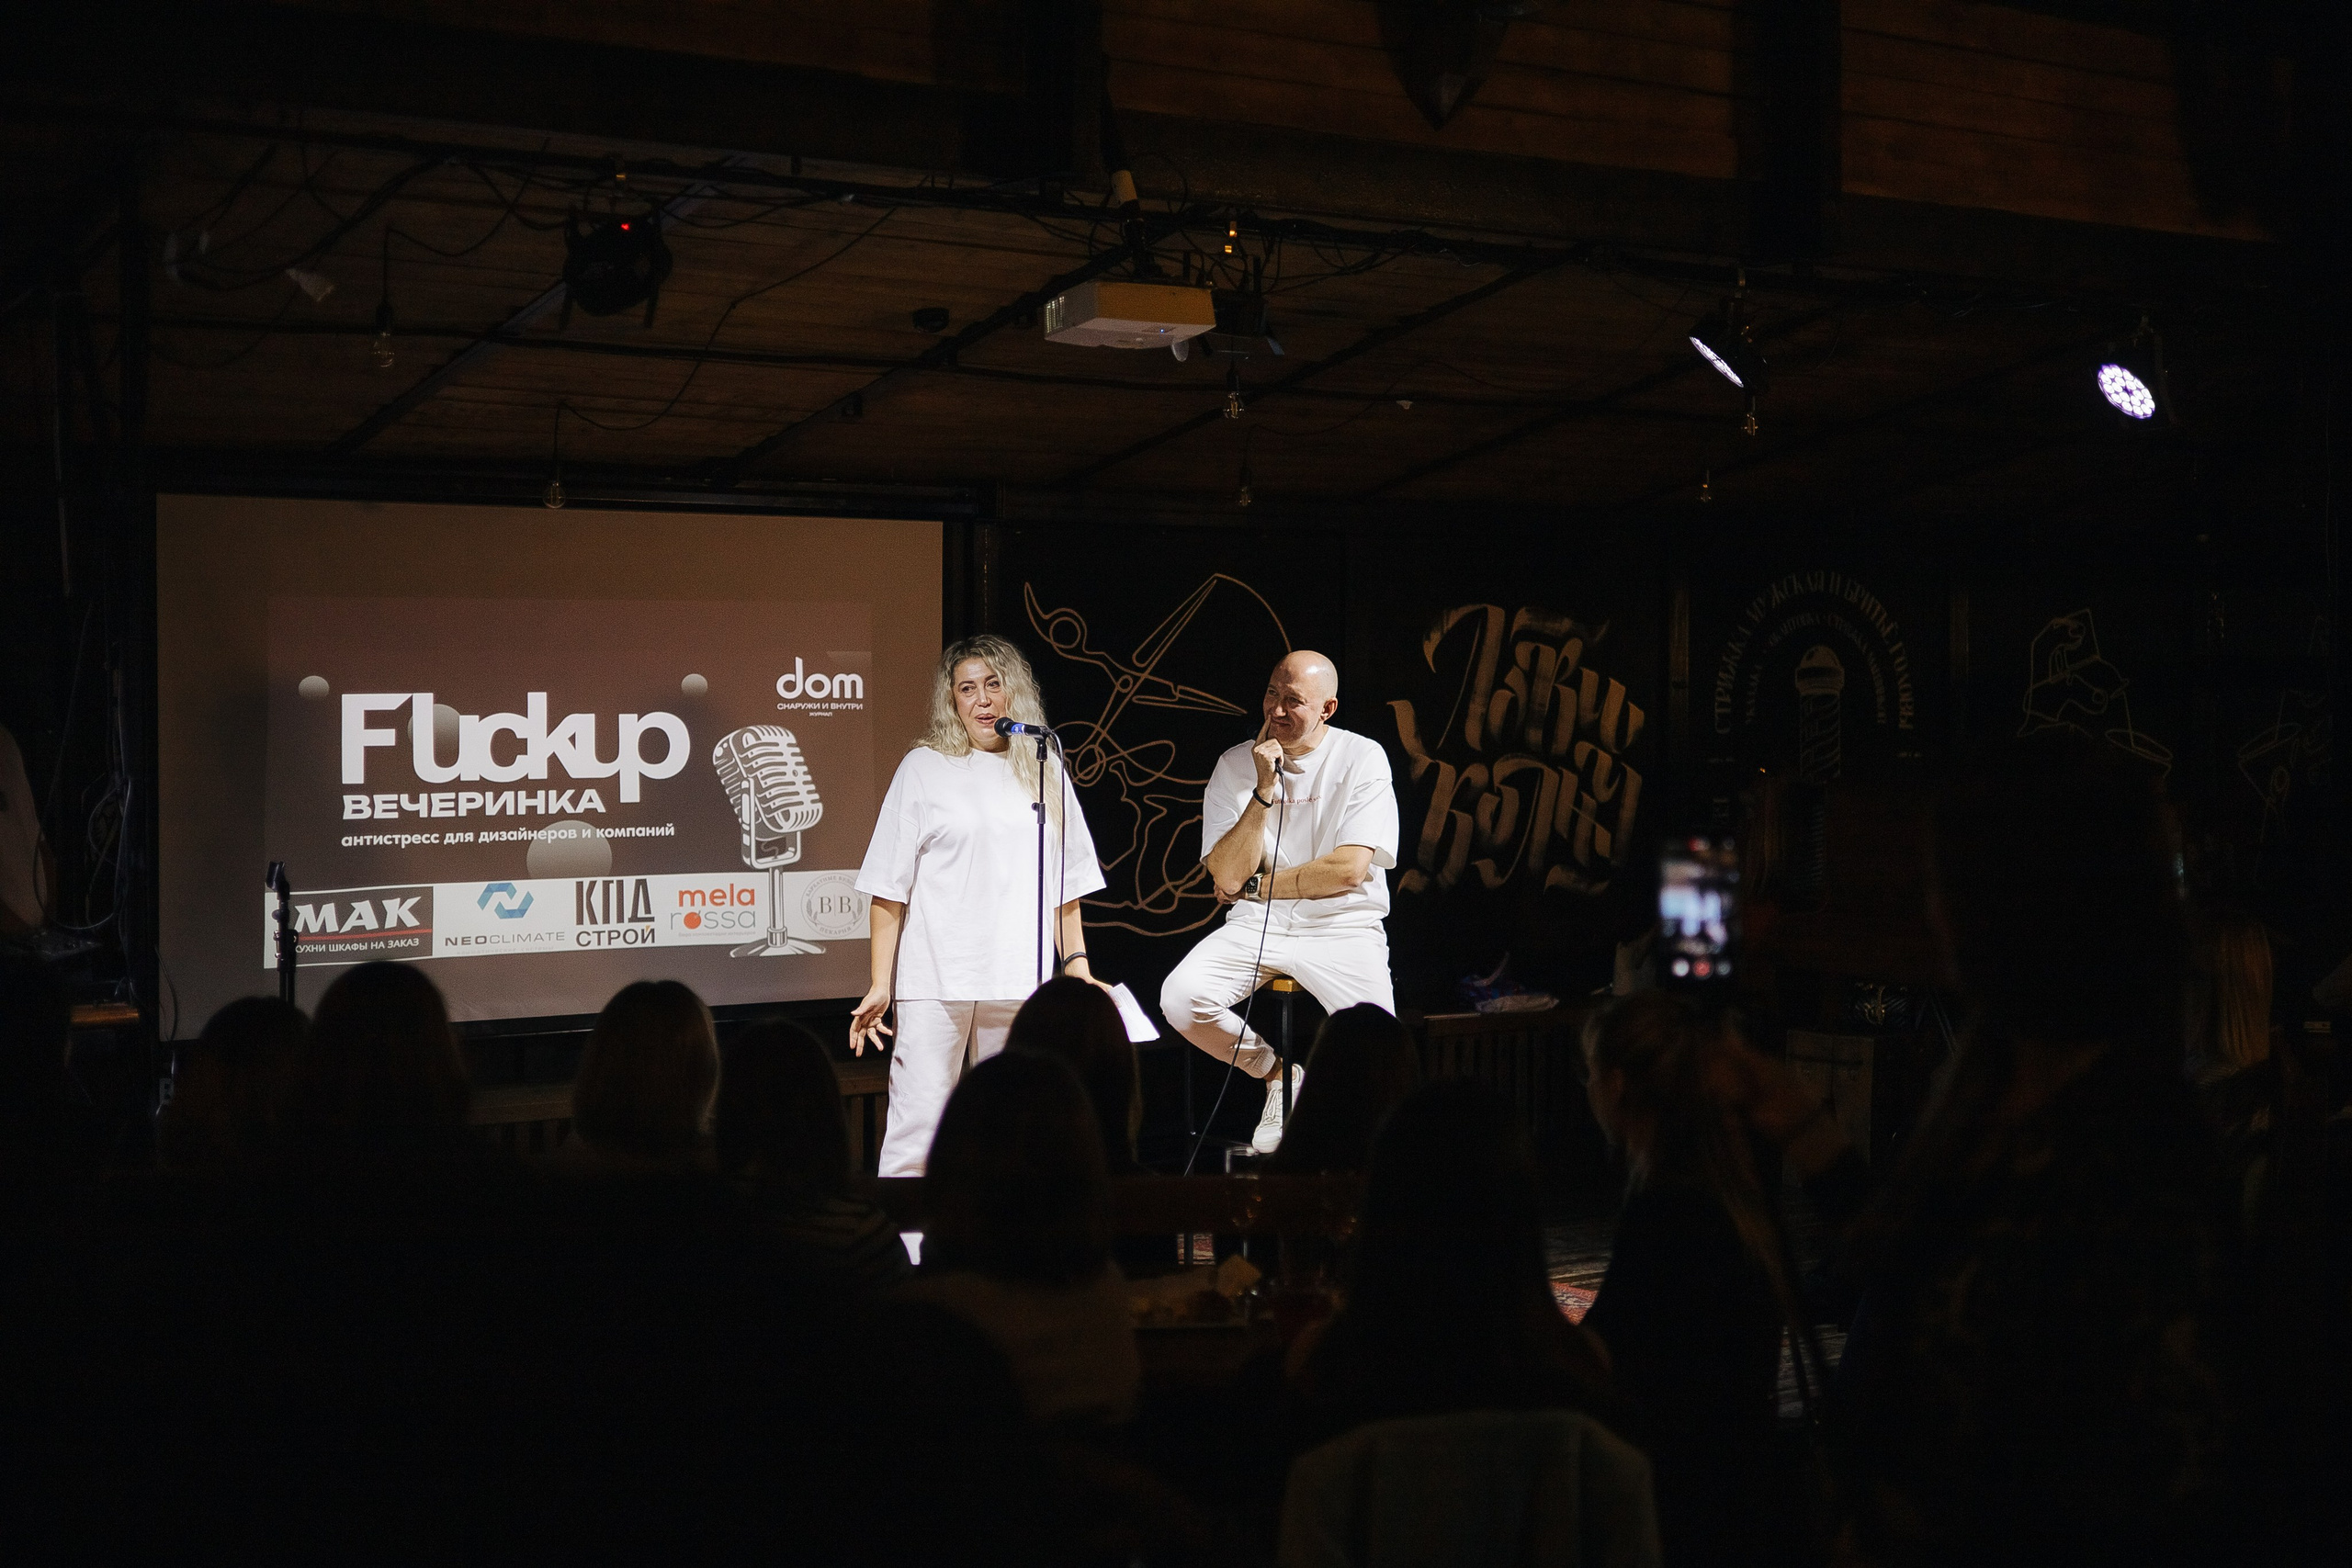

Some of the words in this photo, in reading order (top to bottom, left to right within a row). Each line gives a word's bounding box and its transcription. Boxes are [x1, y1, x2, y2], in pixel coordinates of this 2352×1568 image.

[775, 656, 864, 700] dom
[776, 703, 820, 711] СНАРУЖИ
[343, 789, 606, 820] ВЕЧЕРИНКА
[341, 832, 440, 849] антистресс
[443, 831, 474, 845] для
[478, 827, 578, 844] дизайнеров
[582, 829, 592, 839] и
[596, 823, 675, 839] компаний
[575, 878, 656, 926] КПД
[678, 883, 756, 908] mela
[294, 897, 422, 933] МАК
[329, 942, 368, 953] ШКАФЫ
[370, 941, 385, 950] НА
[388, 938, 420, 949] ЗАКАЗ
[445, 931, 565, 946] NEOCLIMATE
[576, 926, 656, 947] СТРОЙ
